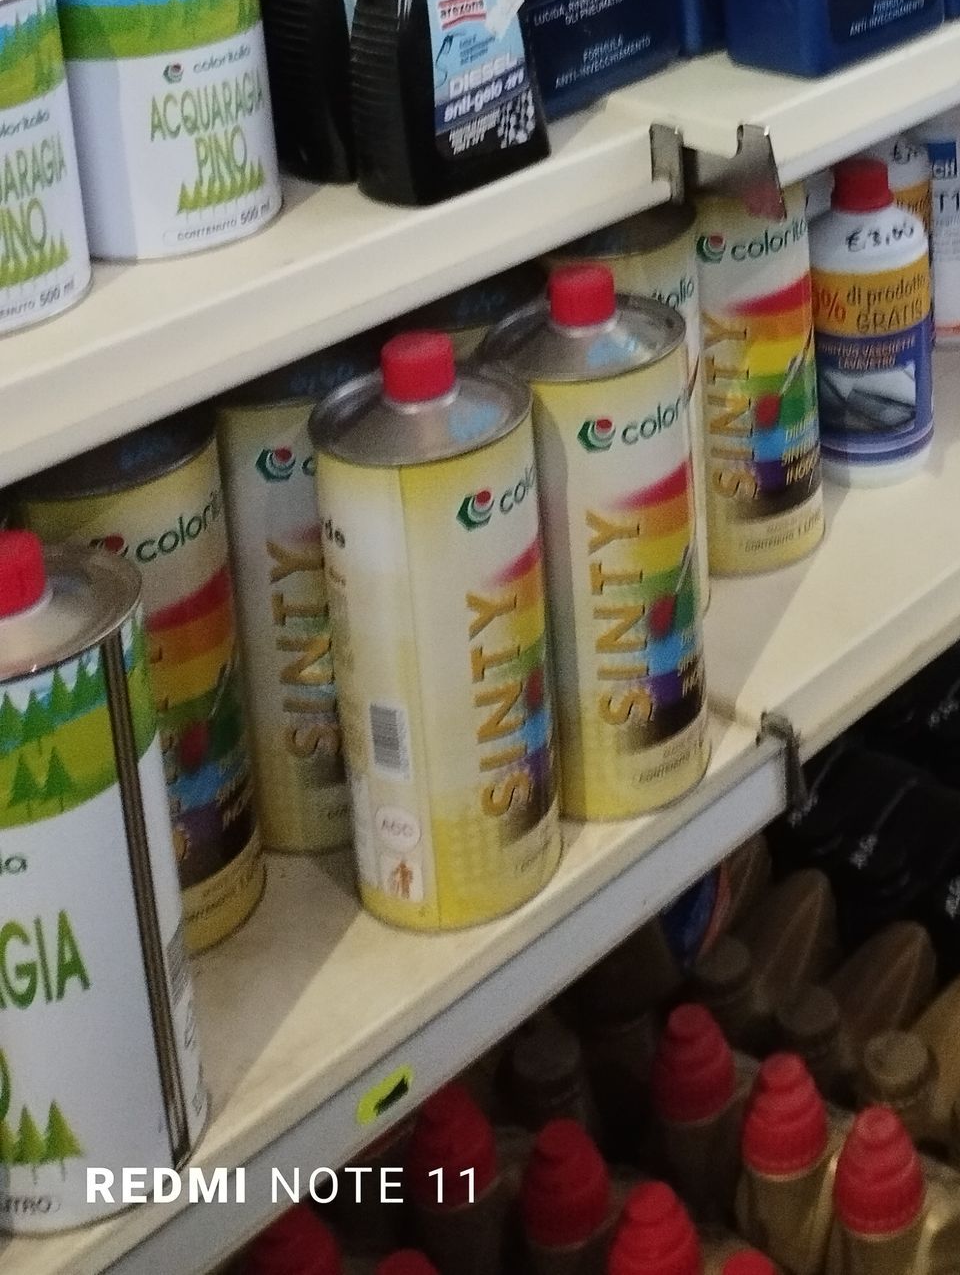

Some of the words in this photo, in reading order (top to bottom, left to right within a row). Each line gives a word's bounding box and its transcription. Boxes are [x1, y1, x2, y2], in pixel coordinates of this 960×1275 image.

[440, 0, 485, 20] arexons
[0, 131, 67, 205] ARAGIA
[194, 123, 248, 186] PINO
[240, 207, 260, 225] 500
[39, 287, 61, 309] 500
[847, 285, 861, 305] di
[704, 311, 759, 500] SINTY
[267, 540, 342, 759] SINTY
[586, 509, 654, 727] SINTY
[466, 590, 534, 818] SINTY
[0, 908, 91, 1011] GIA
